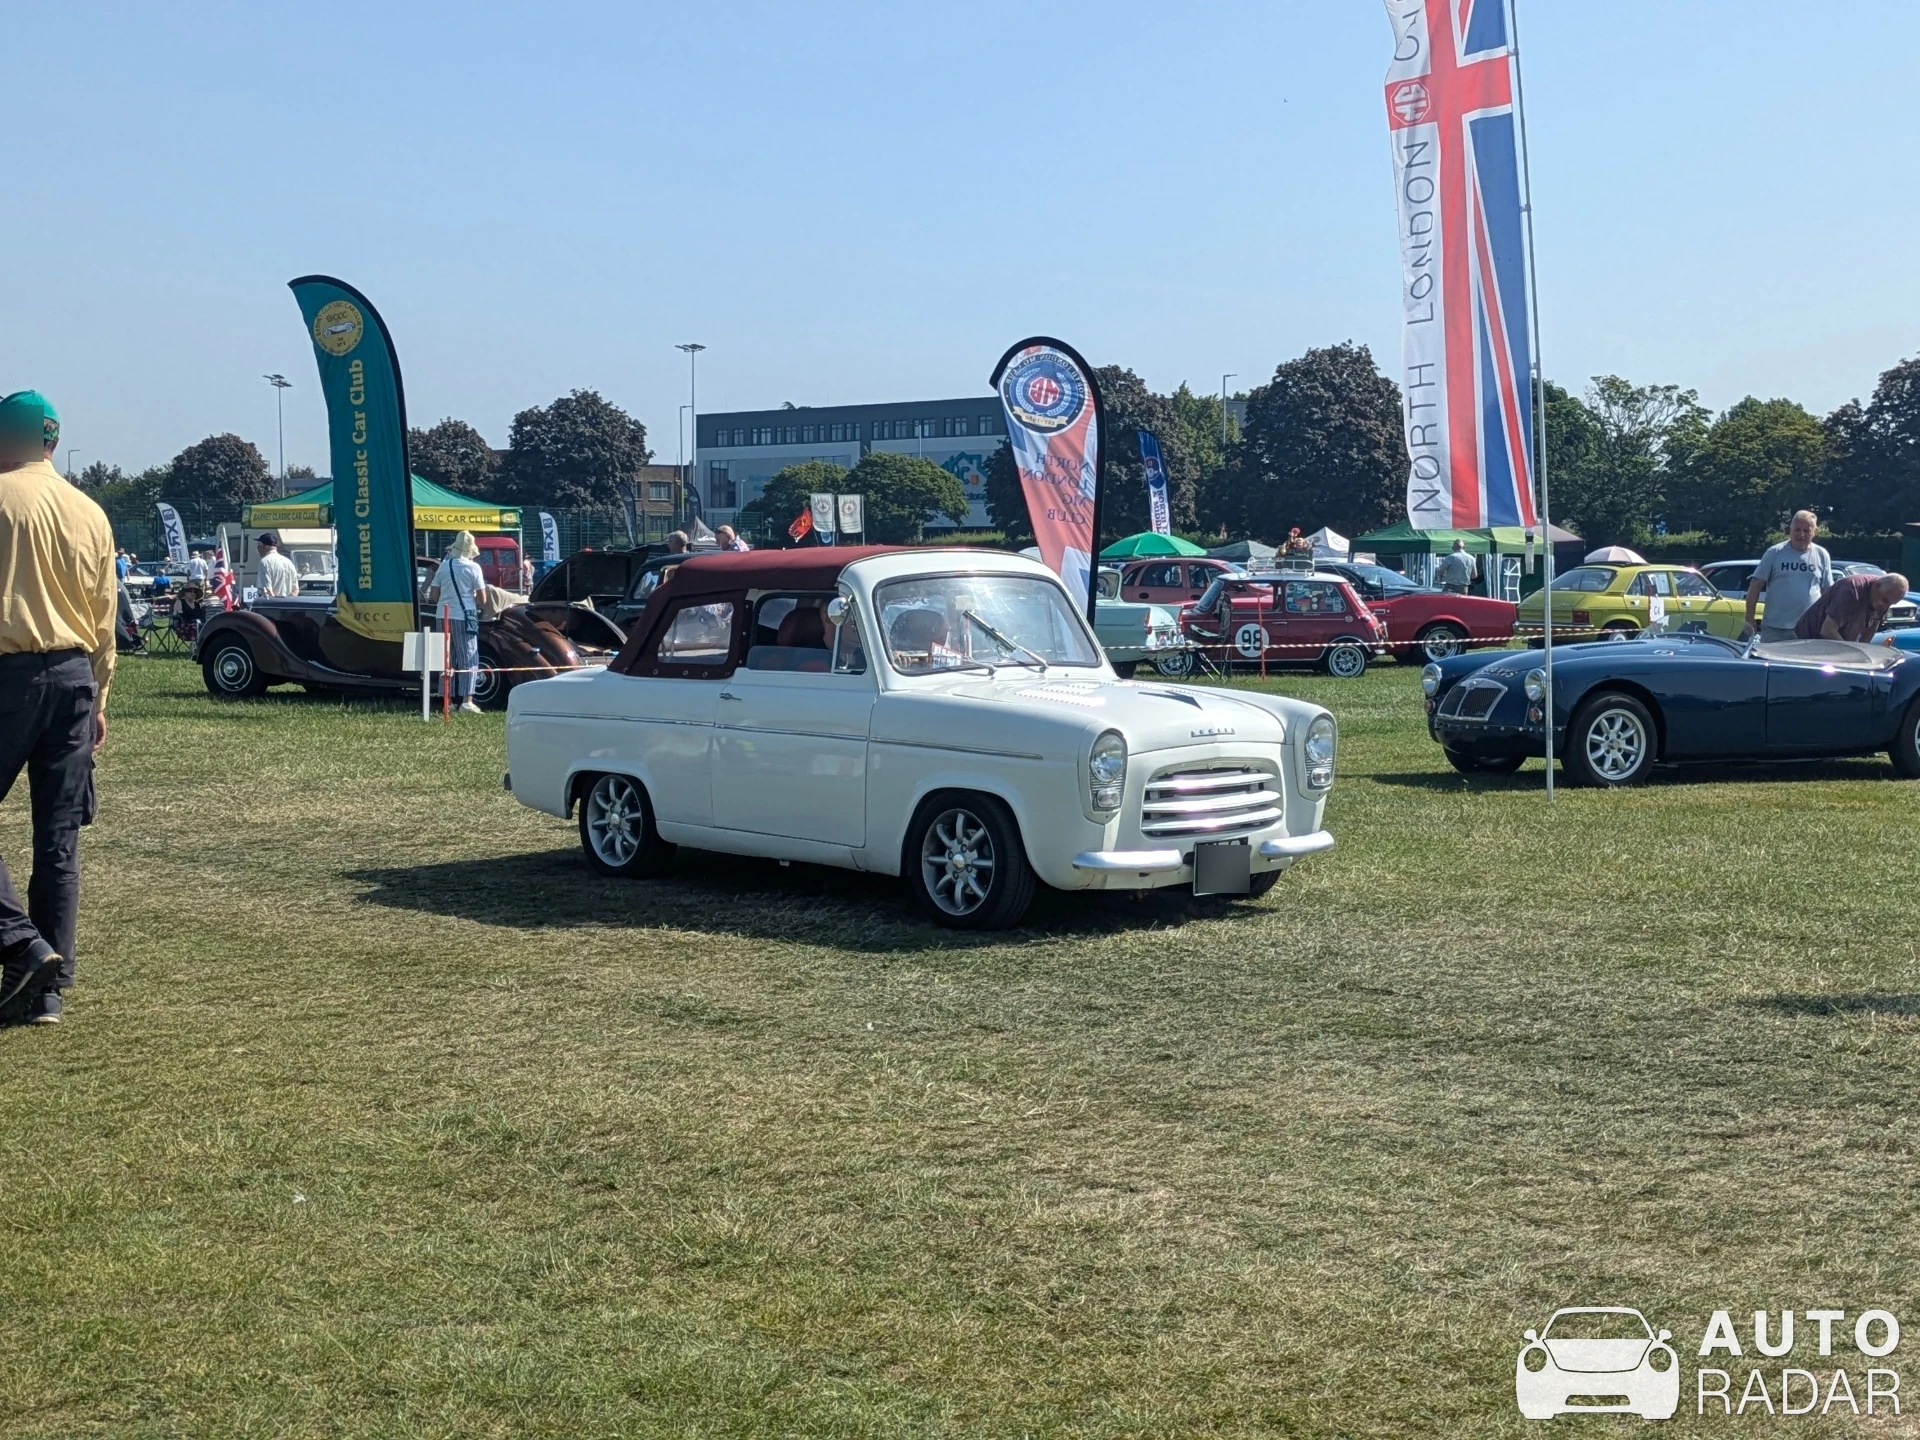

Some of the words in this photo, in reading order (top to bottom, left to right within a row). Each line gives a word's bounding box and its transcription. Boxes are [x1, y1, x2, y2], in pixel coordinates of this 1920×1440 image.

[1403, 141, 1434, 324] LONDON
[326, 311, 348, 322] BCCC
[349, 359, 365, 406] Club
[352, 411, 367, 444] Car
[1407, 363, 1440, 511] NORTH
[353, 449, 371, 518] Classic
[414, 514, 444, 523] ASSIC
[446, 515, 466, 523] CAR
[468, 515, 493, 524] CLUB
[357, 522, 372, 590] Barnet
[1781, 562, 1816, 572] HUGO
